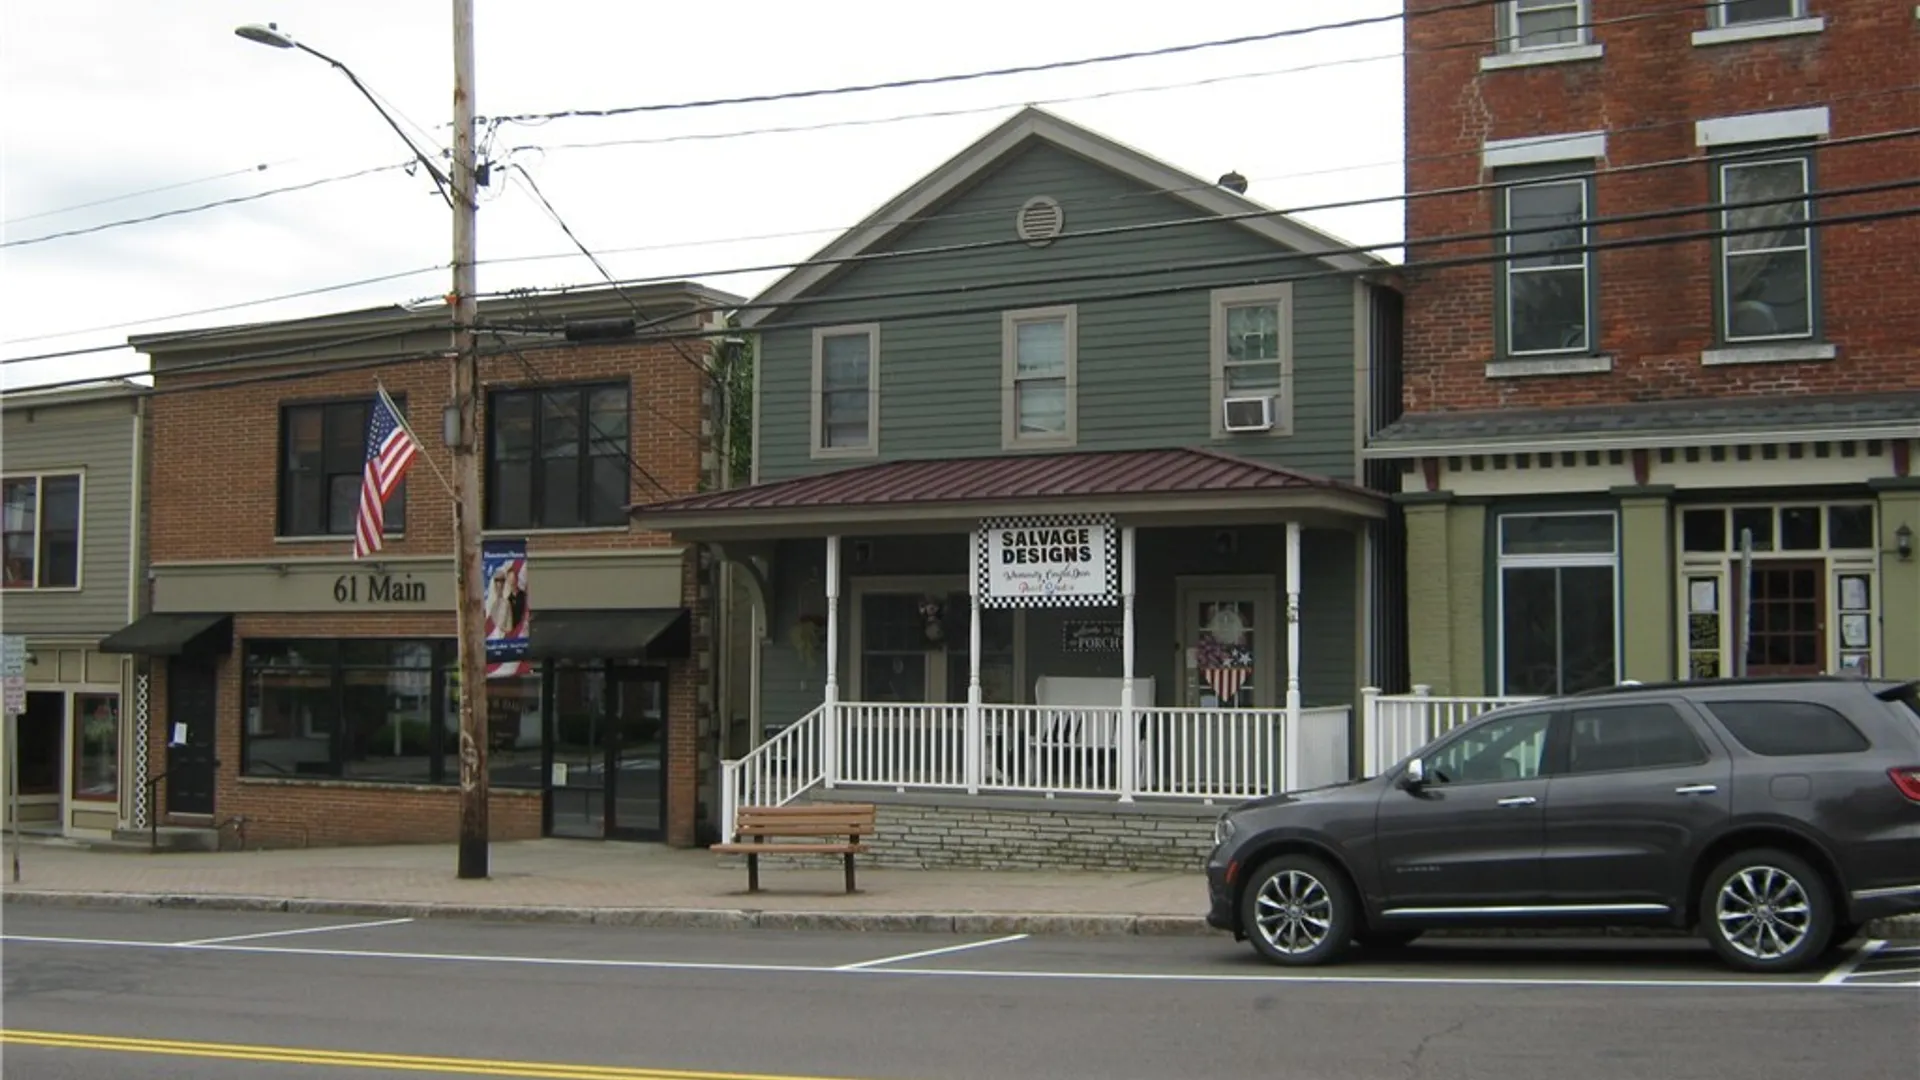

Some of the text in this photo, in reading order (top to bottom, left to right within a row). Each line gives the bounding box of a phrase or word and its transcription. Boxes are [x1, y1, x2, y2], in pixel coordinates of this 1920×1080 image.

[1002, 529, 1089, 546] SALVAGE
[1002, 546, 1092, 564] DESIGNS
[333, 572, 426, 603] 61 Main
